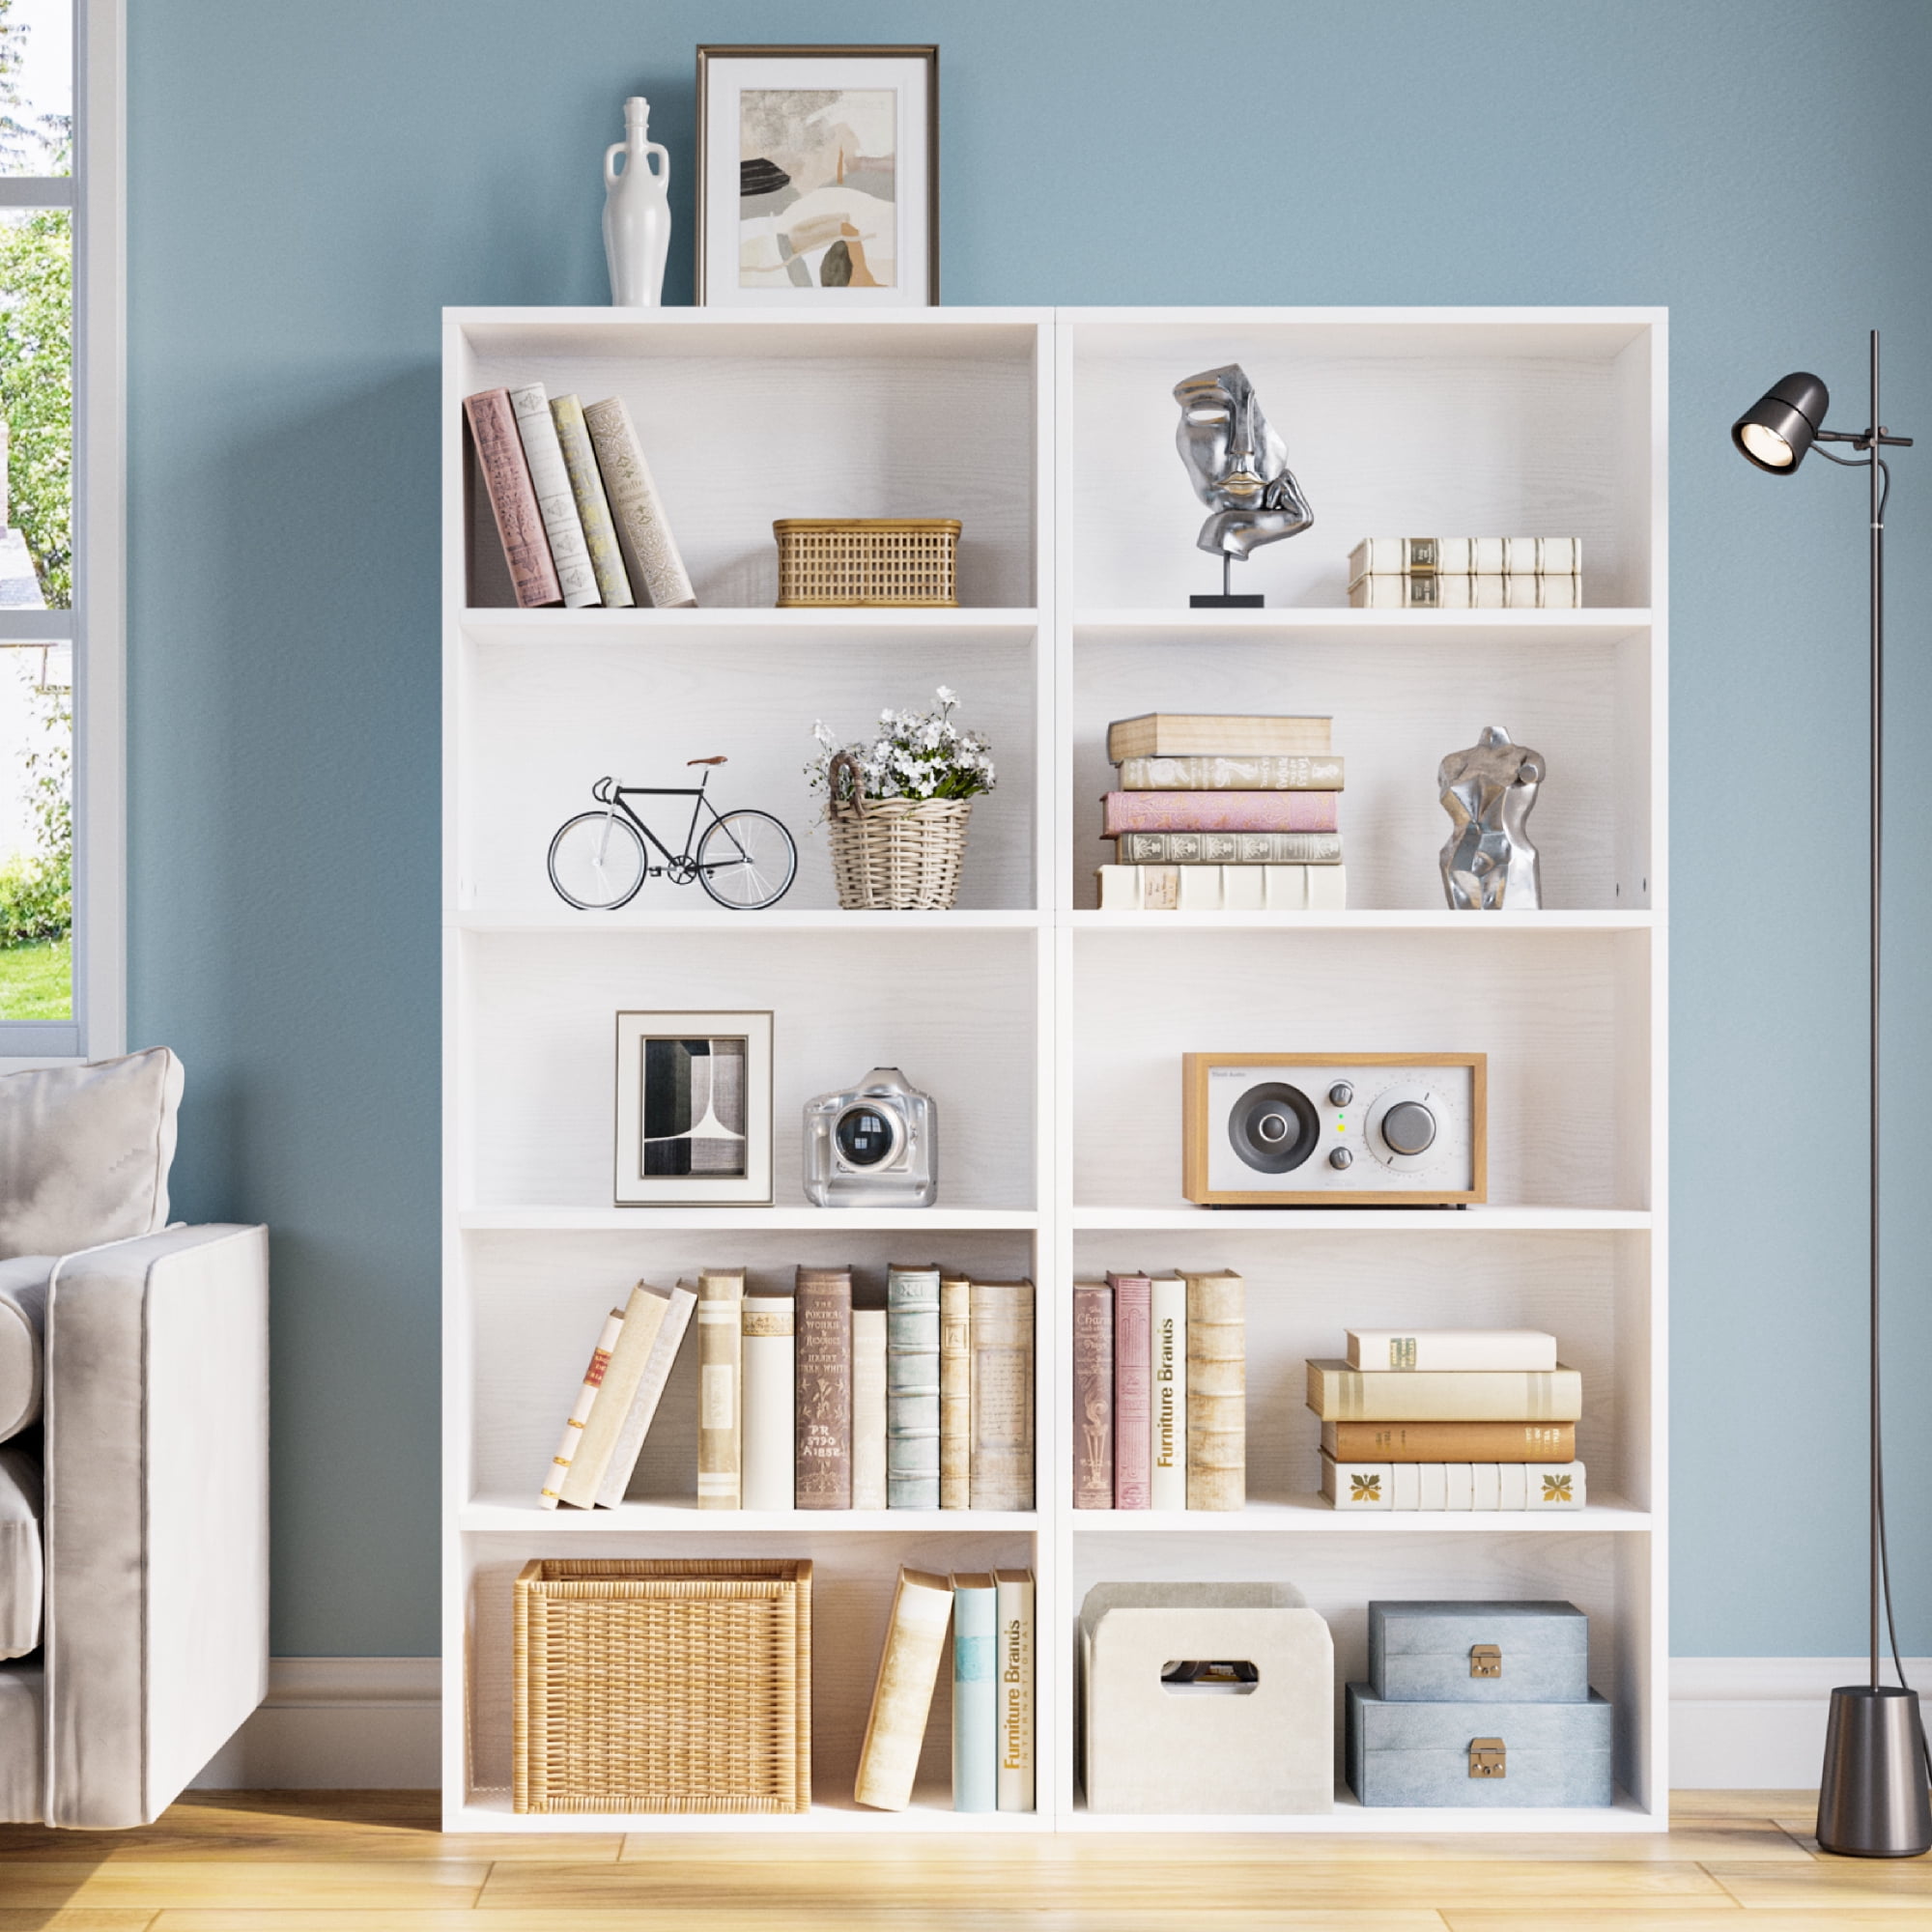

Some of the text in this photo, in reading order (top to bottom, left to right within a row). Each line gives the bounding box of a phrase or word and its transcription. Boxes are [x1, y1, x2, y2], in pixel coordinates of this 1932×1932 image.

[809, 1425, 830, 1435] PR
[1156, 1319, 1175, 1468] Furniture Brands
[1003, 1619, 1021, 1770] Furniture Brands
